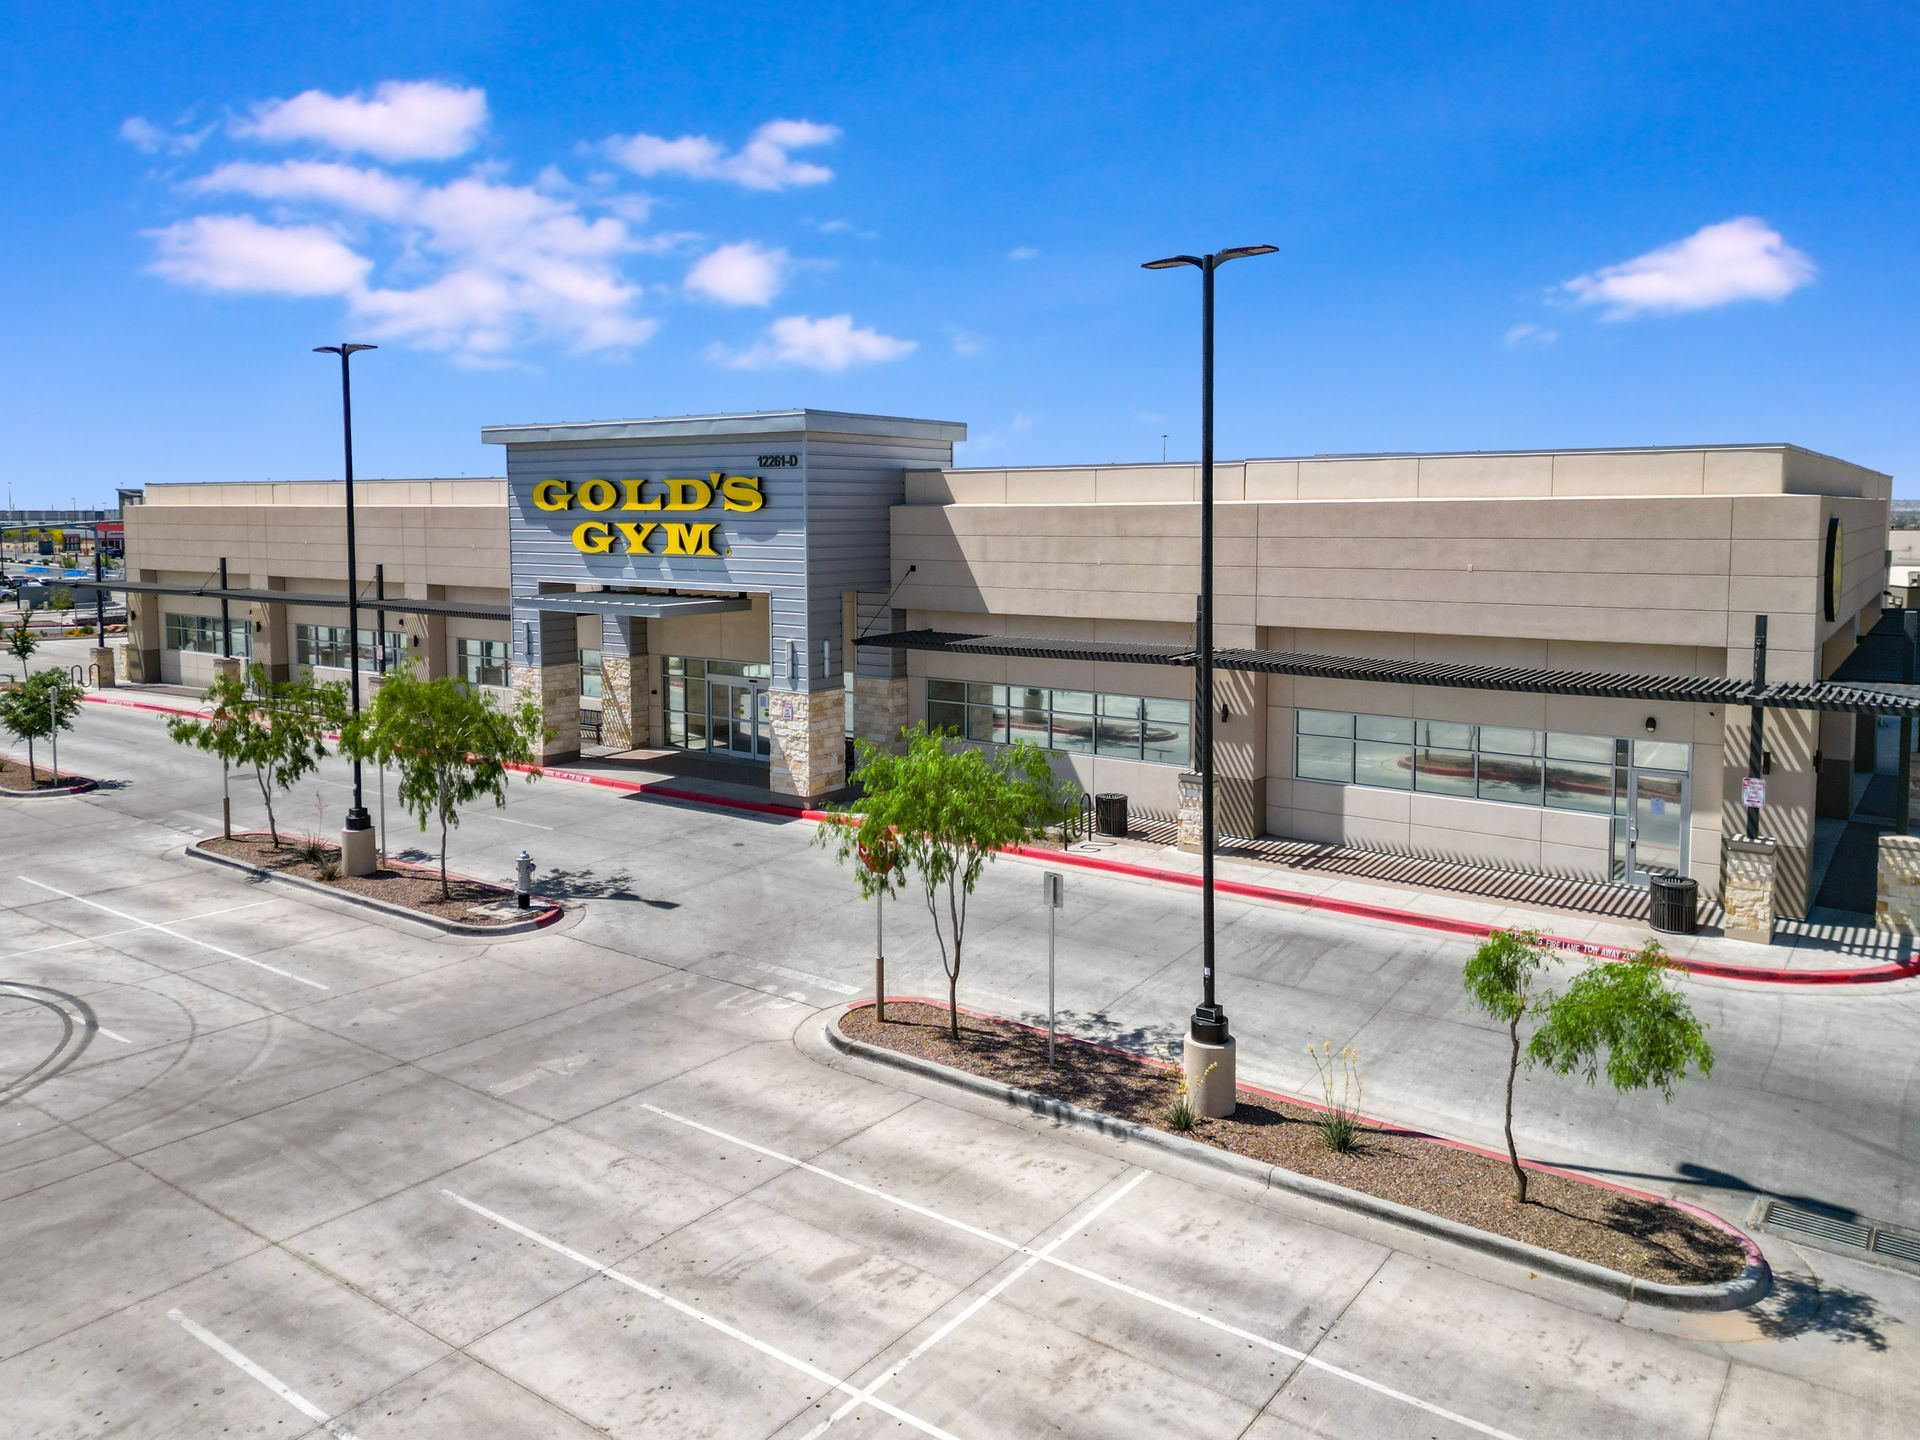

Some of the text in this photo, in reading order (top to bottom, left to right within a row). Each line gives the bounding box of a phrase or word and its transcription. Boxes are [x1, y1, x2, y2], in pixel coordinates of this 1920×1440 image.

[757, 454, 798, 467] 12261-D
[532, 473, 766, 512] GOLD'S
[571, 521, 722, 556] GYM
[1545, 939, 1561, 950] FIRE
[1562, 942, 1580, 954] LANE
[1583, 944, 1600, 955] TOW
[1600, 947, 1621, 959] AWAY
